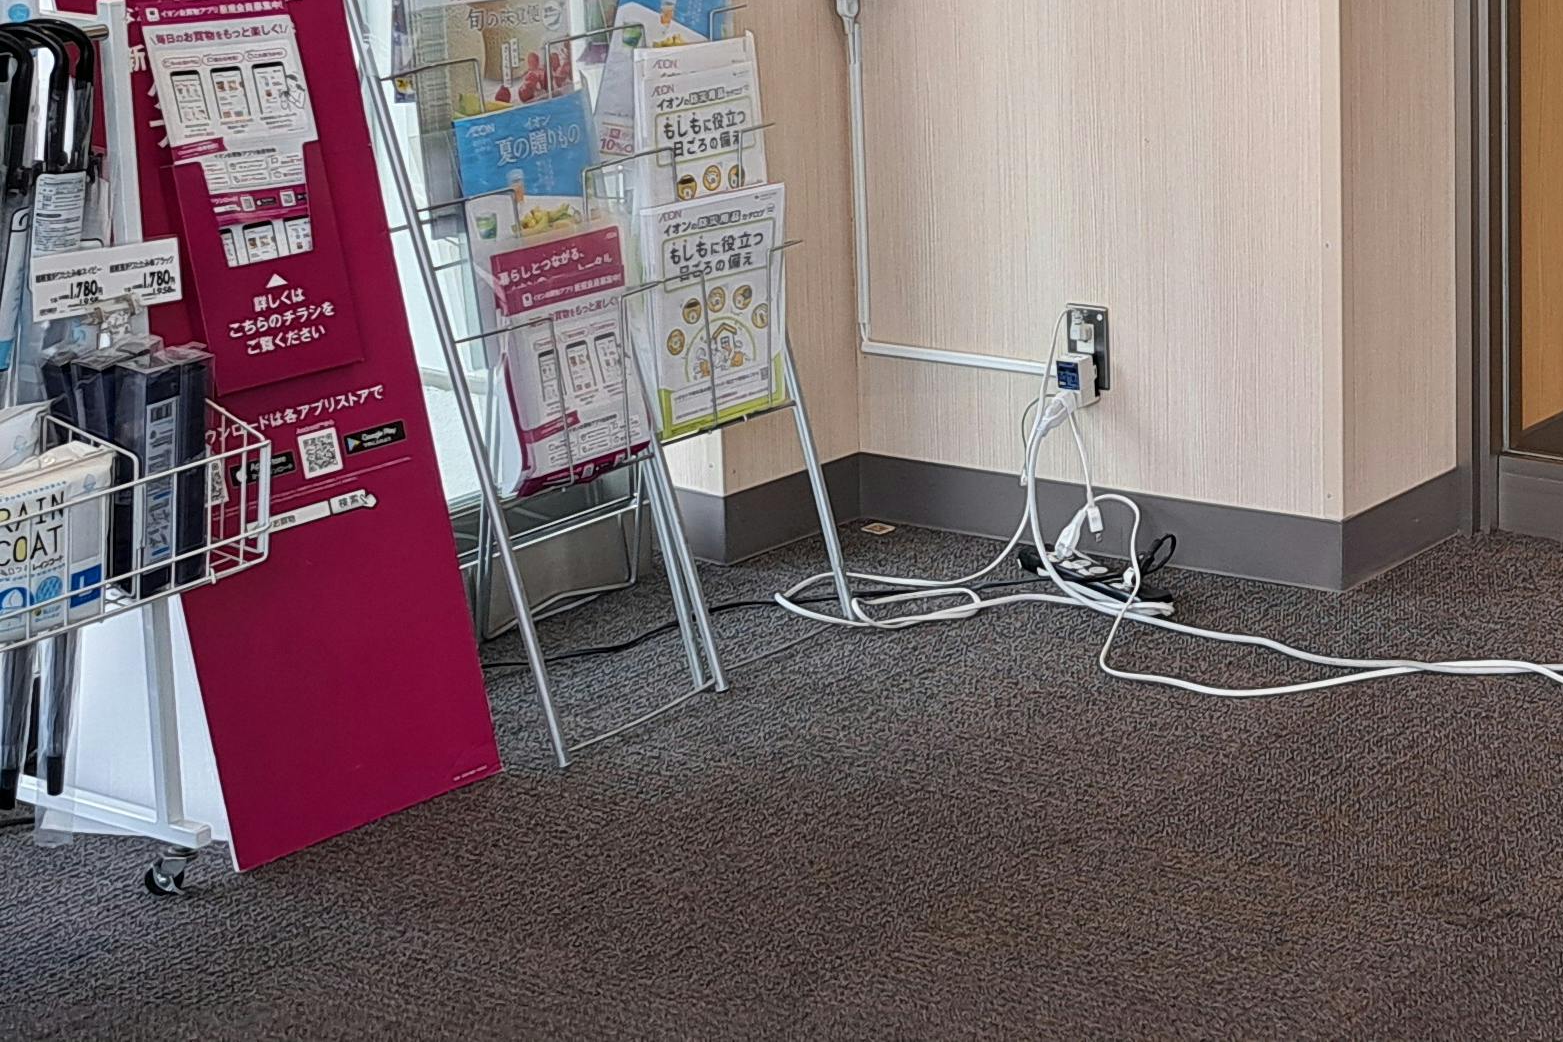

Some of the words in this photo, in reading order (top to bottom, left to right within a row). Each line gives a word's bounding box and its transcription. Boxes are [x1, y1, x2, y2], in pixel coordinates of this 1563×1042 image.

[663, 109, 746, 140] もしもに役立つ
[495, 124, 581, 167] 夏の贈りもの
[670, 230, 764, 265] もしもに役立つ
[252, 287, 305, 312] 詳しくは
[228, 301, 335, 338] こちらのチラシを
[246, 324, 326, 355] ご覧ください
